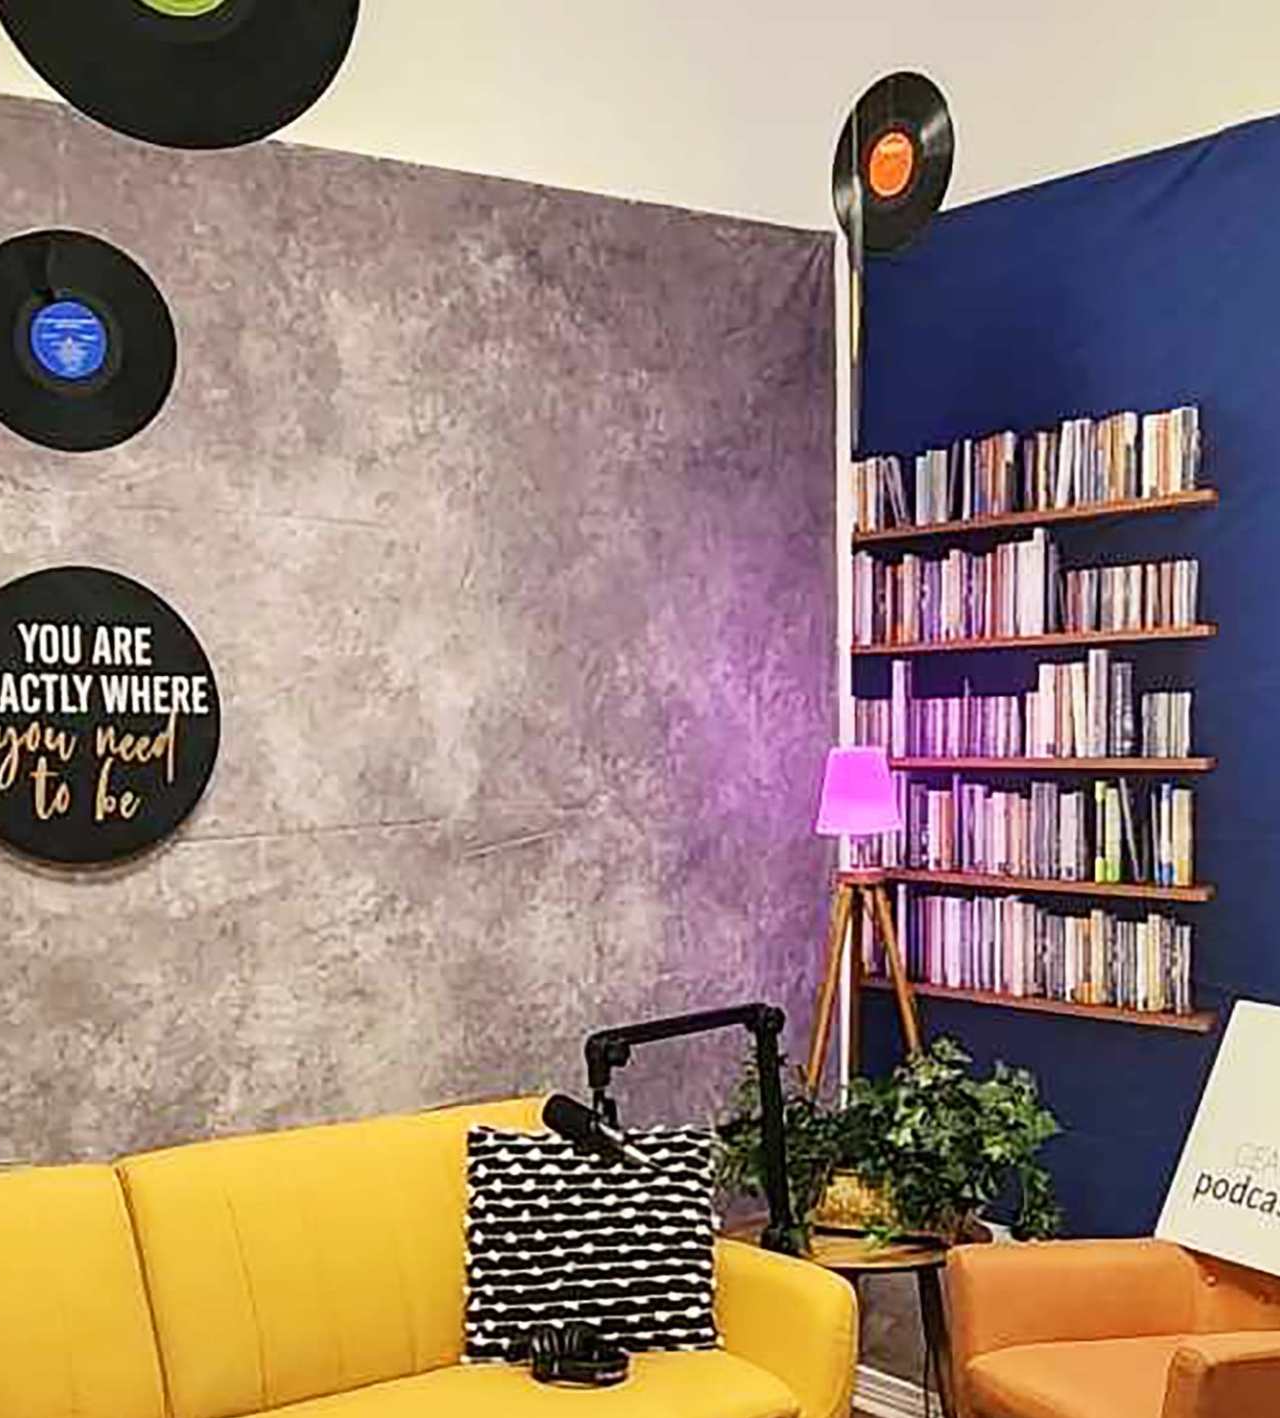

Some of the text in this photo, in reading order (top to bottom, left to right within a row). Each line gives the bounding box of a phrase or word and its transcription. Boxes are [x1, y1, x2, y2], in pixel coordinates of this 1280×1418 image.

[18, 623, 152, 666] YOU ARE
[100, 674, 209, 715] WHERE
[96, 711, 176, 783] need
[31, 756, 141, 821] to be
